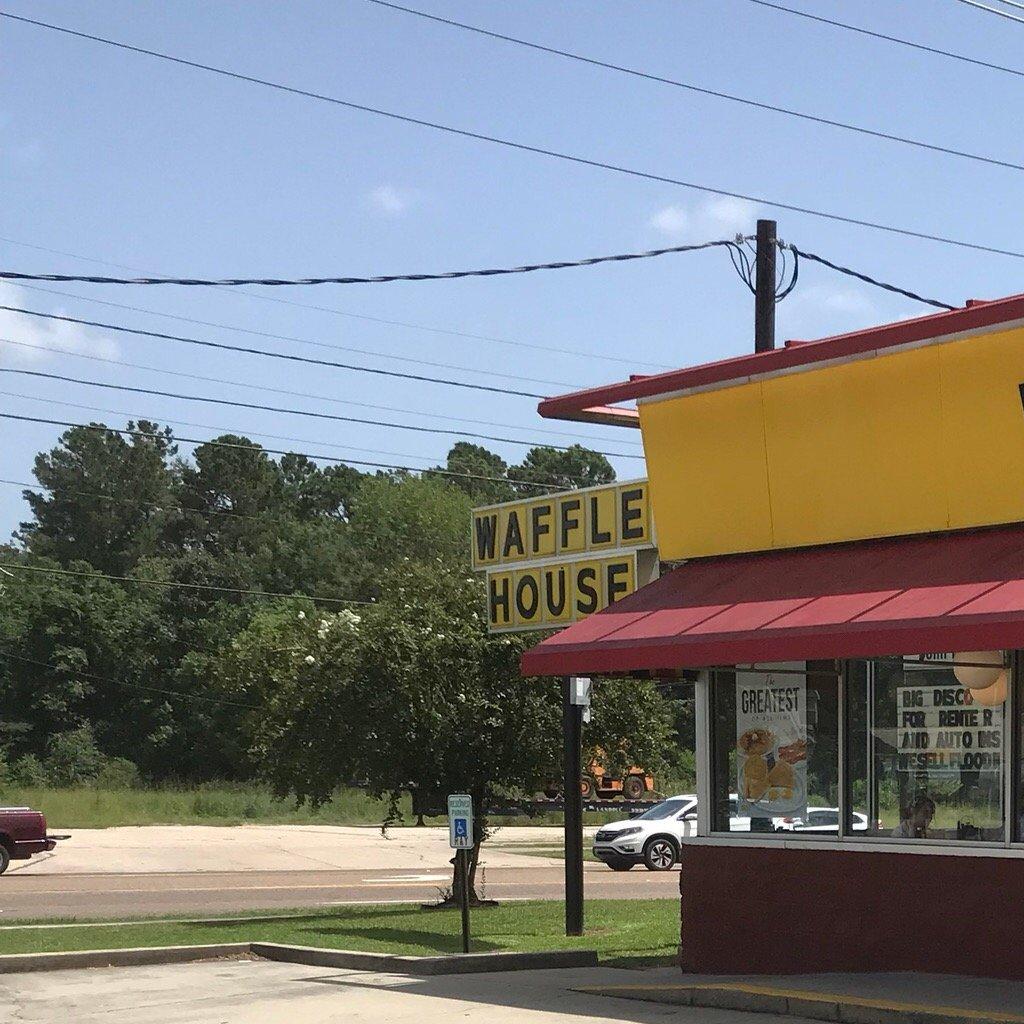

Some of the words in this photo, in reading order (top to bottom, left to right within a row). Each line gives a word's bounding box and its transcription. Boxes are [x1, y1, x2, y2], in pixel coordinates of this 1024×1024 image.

[475, 488, 644, 560] WAFFLE
[490, 563, 629, 624] HOUSE
[741, 686, 800, 714] GREATEST
[902, 690, 923, 708] BIG
[902, 711, 926, 728] FOR
[902, 731, 930, 749] AND
[936, 731, 973, 749] AUTO
